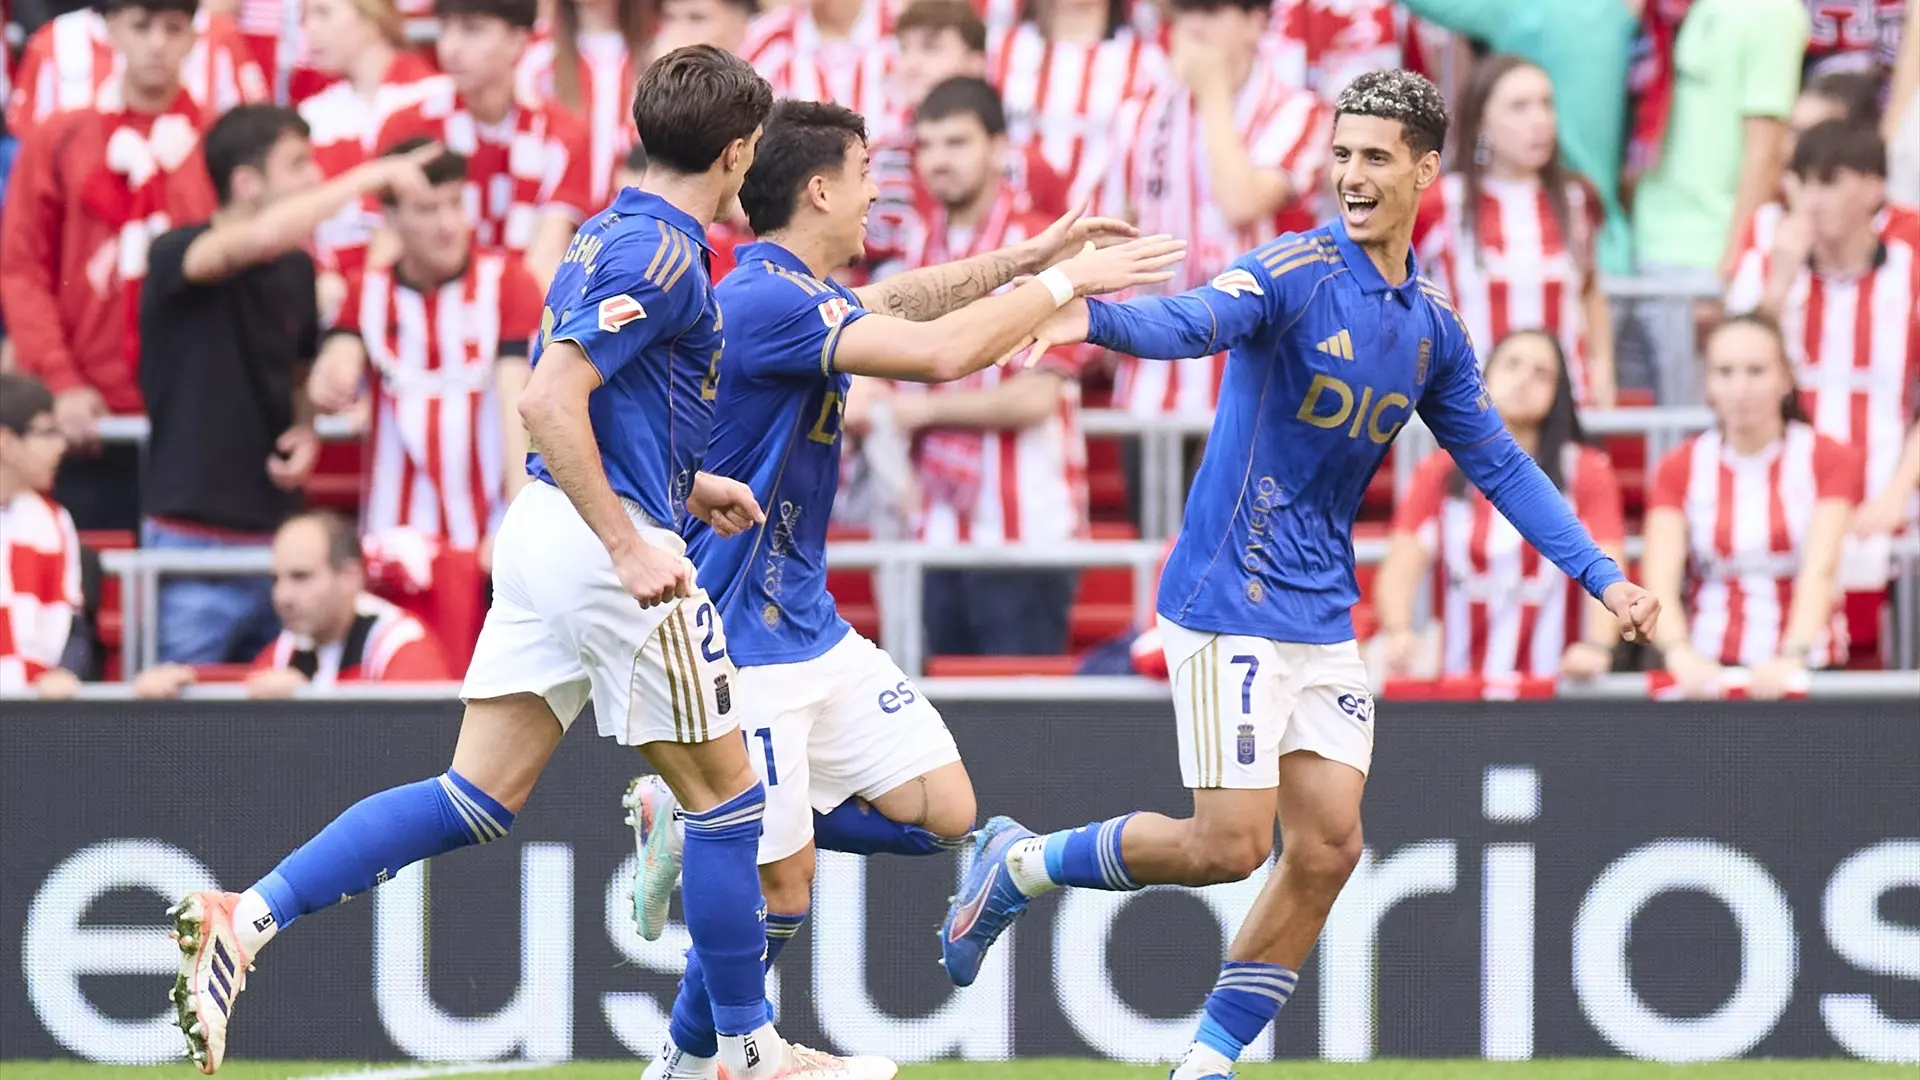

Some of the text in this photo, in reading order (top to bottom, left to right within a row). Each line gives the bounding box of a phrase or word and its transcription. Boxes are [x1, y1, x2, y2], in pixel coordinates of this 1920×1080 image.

[696, 603, 725, 663] 2
[878, 679, 917, 714] es
[1230, 655, 1260, 714] 7
[20, 838, 228, 1064] e
